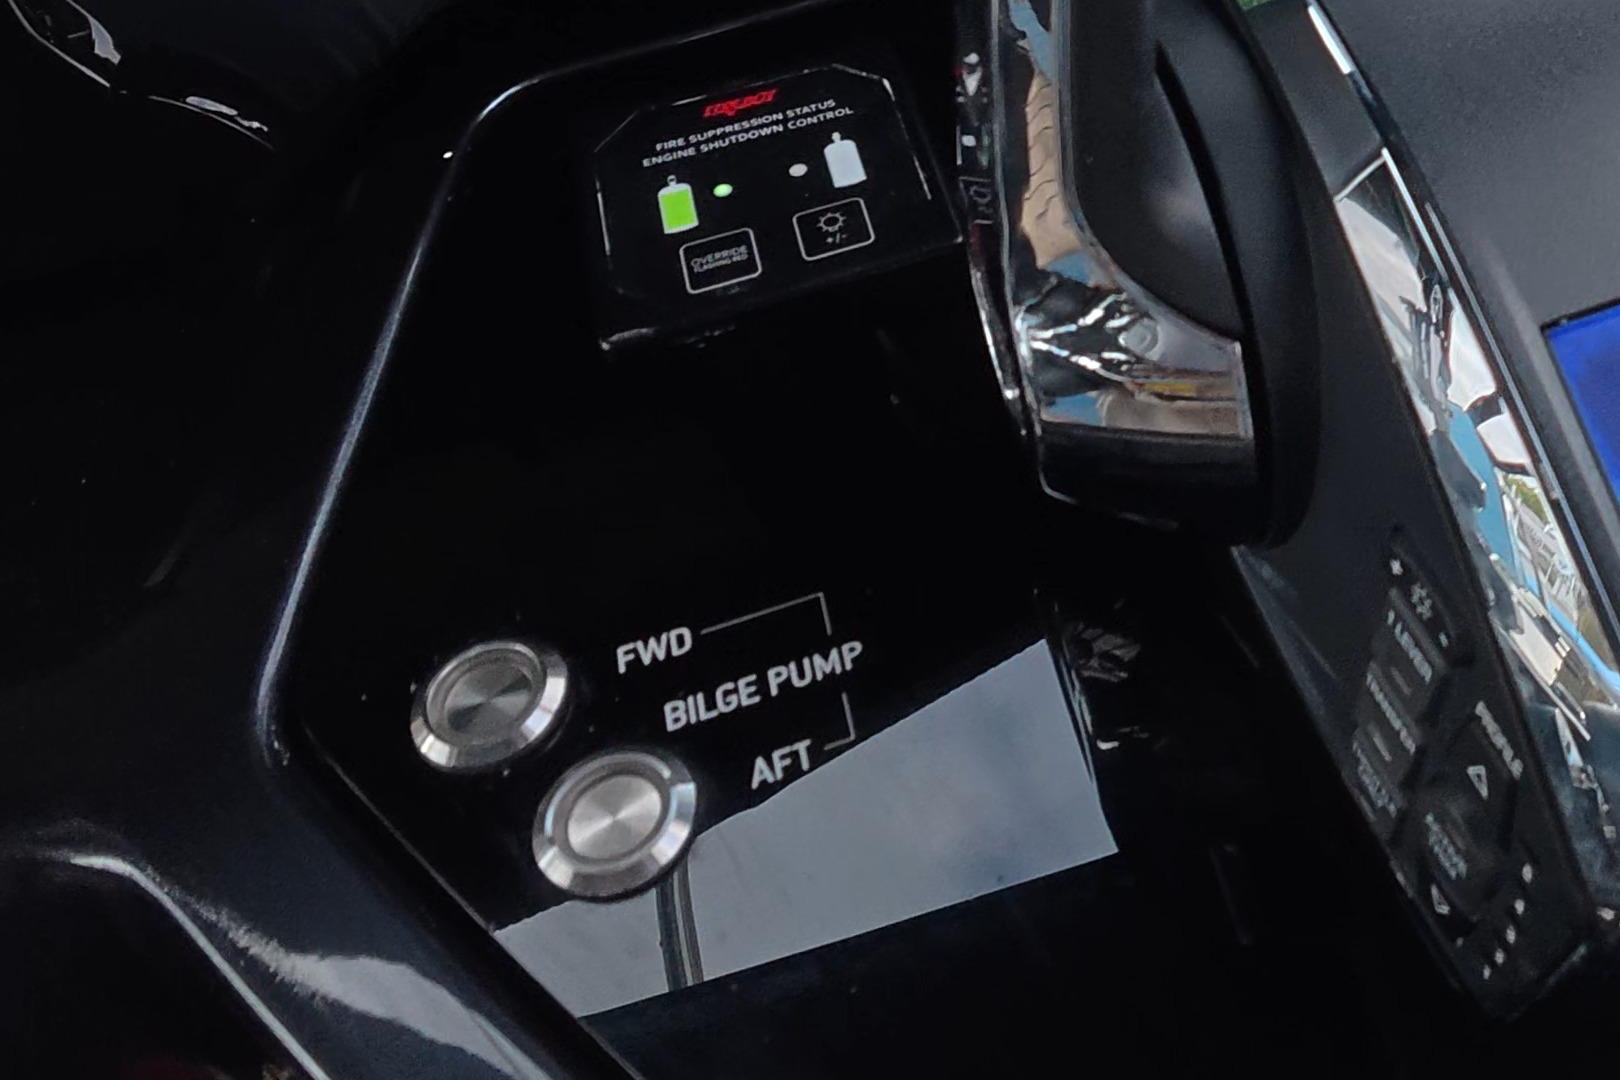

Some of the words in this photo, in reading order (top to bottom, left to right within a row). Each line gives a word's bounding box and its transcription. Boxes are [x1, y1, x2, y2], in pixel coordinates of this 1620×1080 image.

[642, 146, 697, 167] ENGINE
[700, 123, 784, 153] SHUTDOWN
[787, 106, 854, 130] CONTROL
[655, 136, 686, 152] FIRE
[688, 111, 784, 143] SUPPRESSION
[785, 98, 836, 119] STATUS
[616, 626, 693, 674] FWD
[663, 674, 761, 733] BILGE
[766, 640, 863, 697] PUMP
[751, 738, 812, 790] AFT
